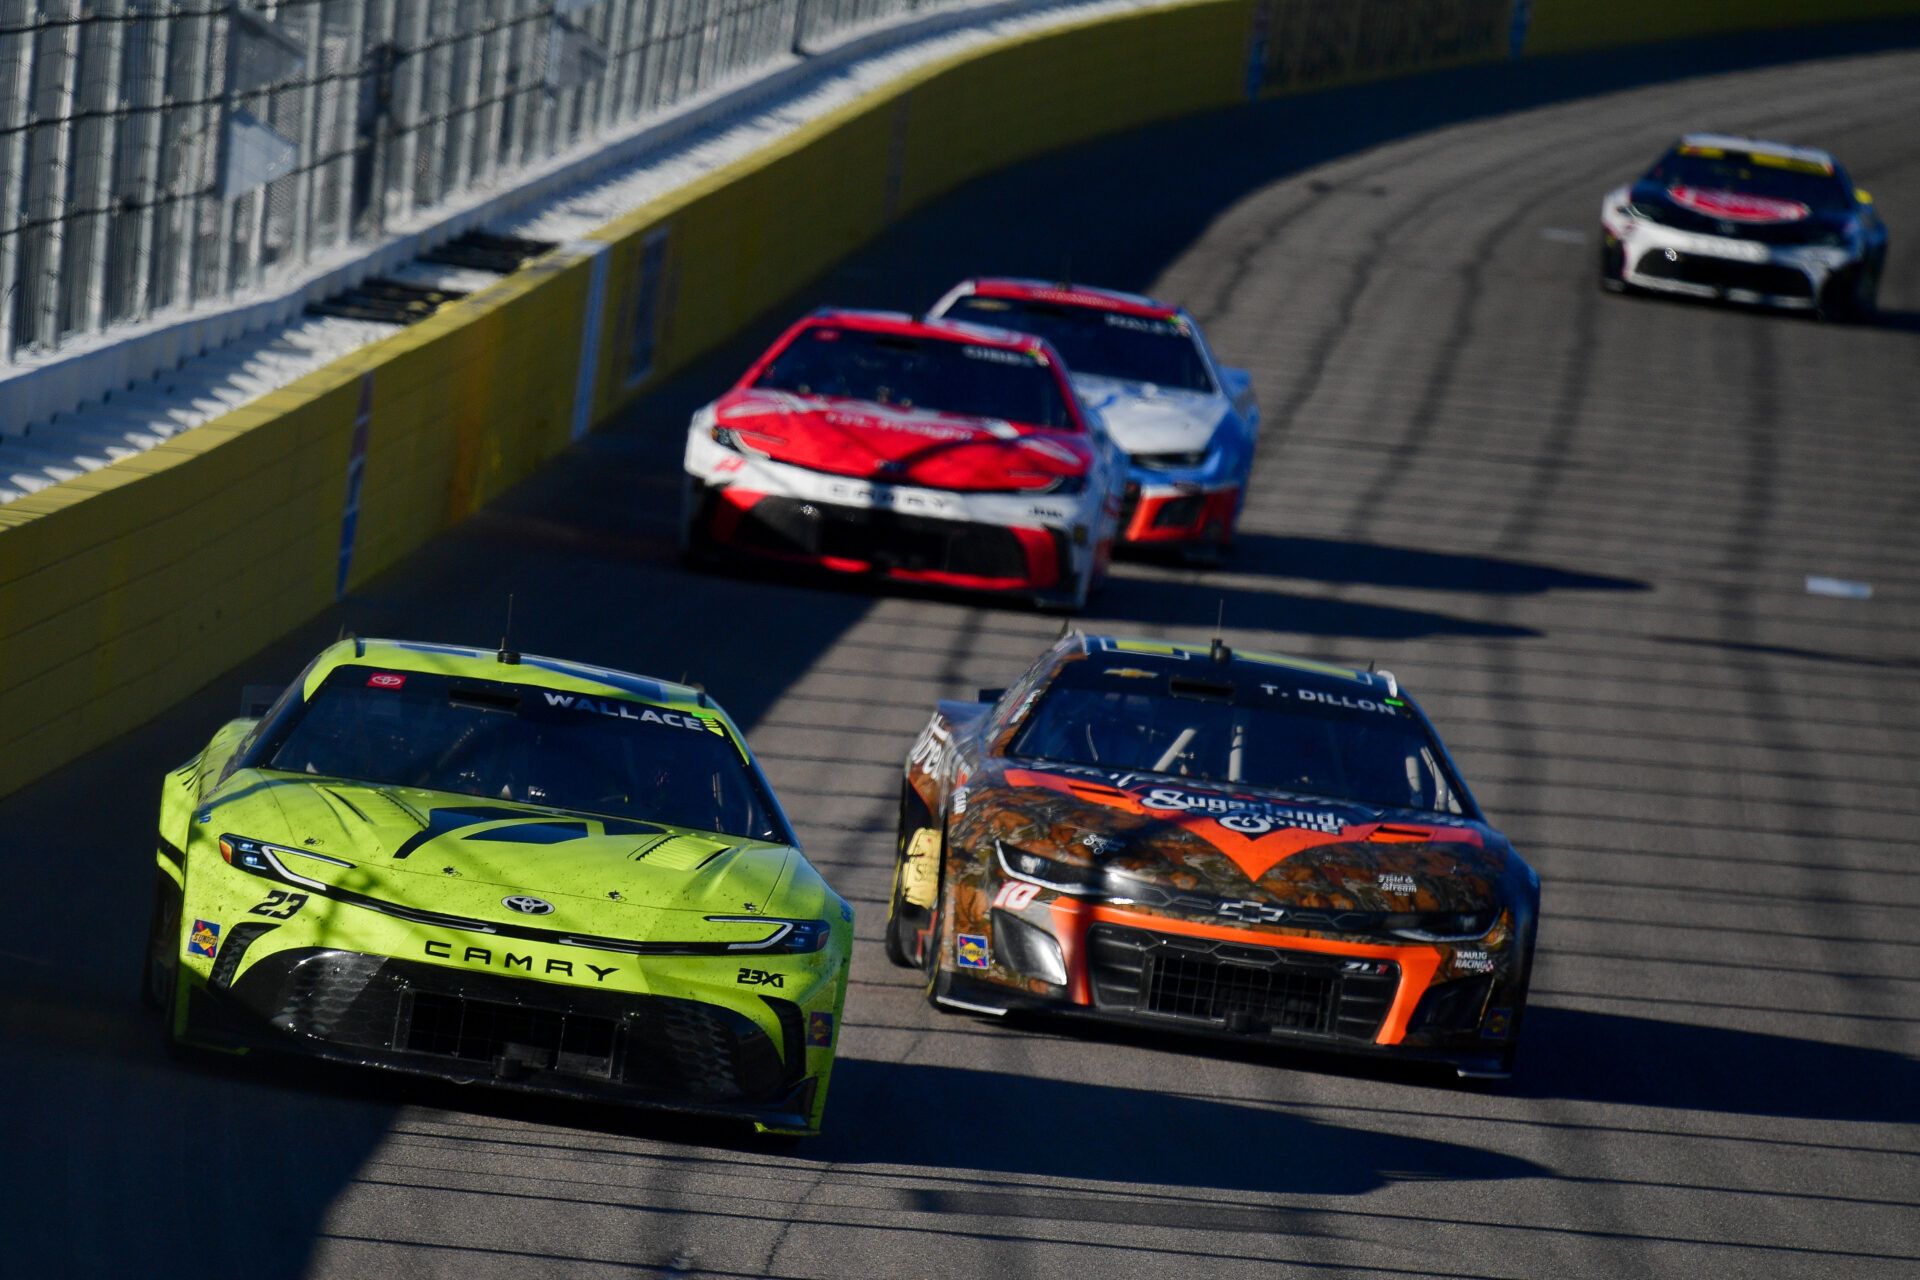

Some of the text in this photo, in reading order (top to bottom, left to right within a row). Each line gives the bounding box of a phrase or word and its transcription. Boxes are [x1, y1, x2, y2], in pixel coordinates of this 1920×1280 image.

[831, 484, 946, 508] CARY
[543, 692, 704, 731] WALLACE
[1260, 683, 1396, 716] T. DILLON
[247, 889, 310, 920] 23
[992, 881, 1042, 910] 10
[193, 931, 218, 947] SUNOCO
[424, 940, 621, 982] CAMRY
[1454, 960, 1488, 970] RACING
[1456, 951, 1488, 960] KAULIG
